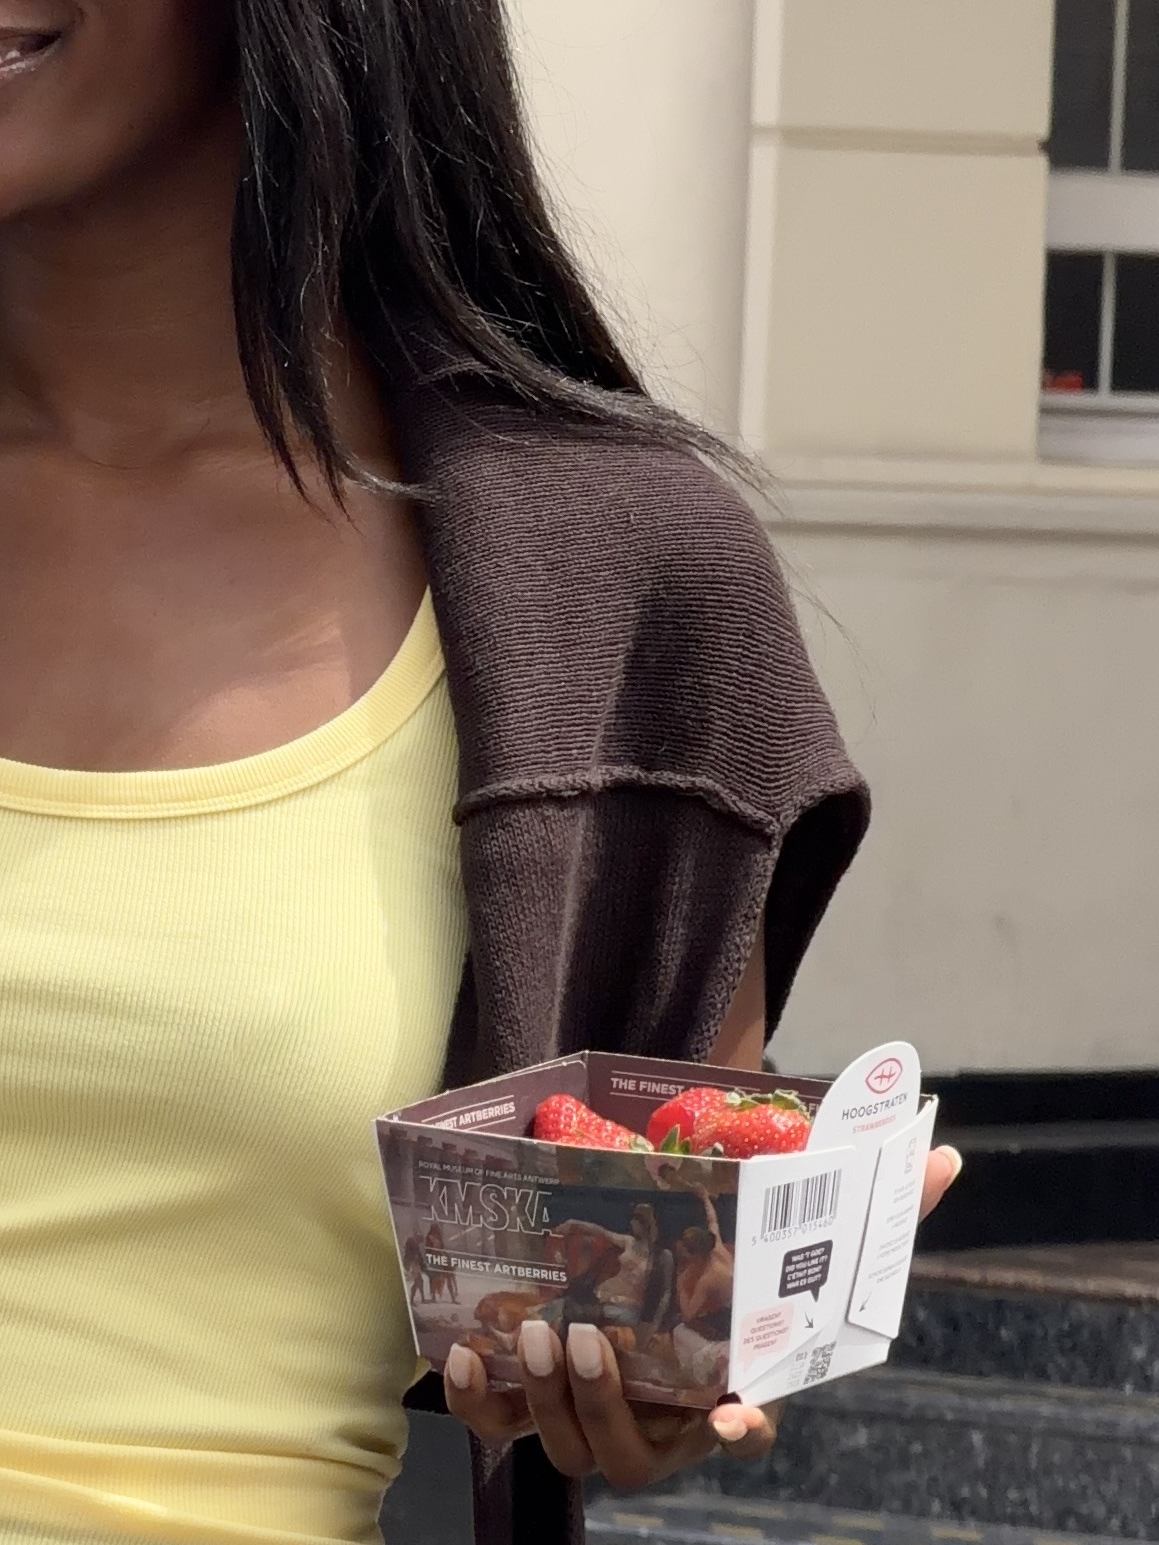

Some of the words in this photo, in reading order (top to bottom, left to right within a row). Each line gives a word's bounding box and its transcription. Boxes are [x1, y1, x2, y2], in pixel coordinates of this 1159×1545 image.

[611, 1078, 636, 1091] THE
[639, 1081, 684, 1096] FINEST
[459, 1102, 516, 1126] ARTBERRIES
[842, 1091, 908, 1120] HOOGSTRATEN
[419, 1160, 442, 1171] ROYAL
[443, 1163, 474, 1175] MUSEUM
[419, 1175, 564, 1238] KMSKA
[426, 1253, 448, 1267] THE
[451, 1257, 491, 1273] FINEST
[494, 1263, 567, 1282] ARTBERRIES
